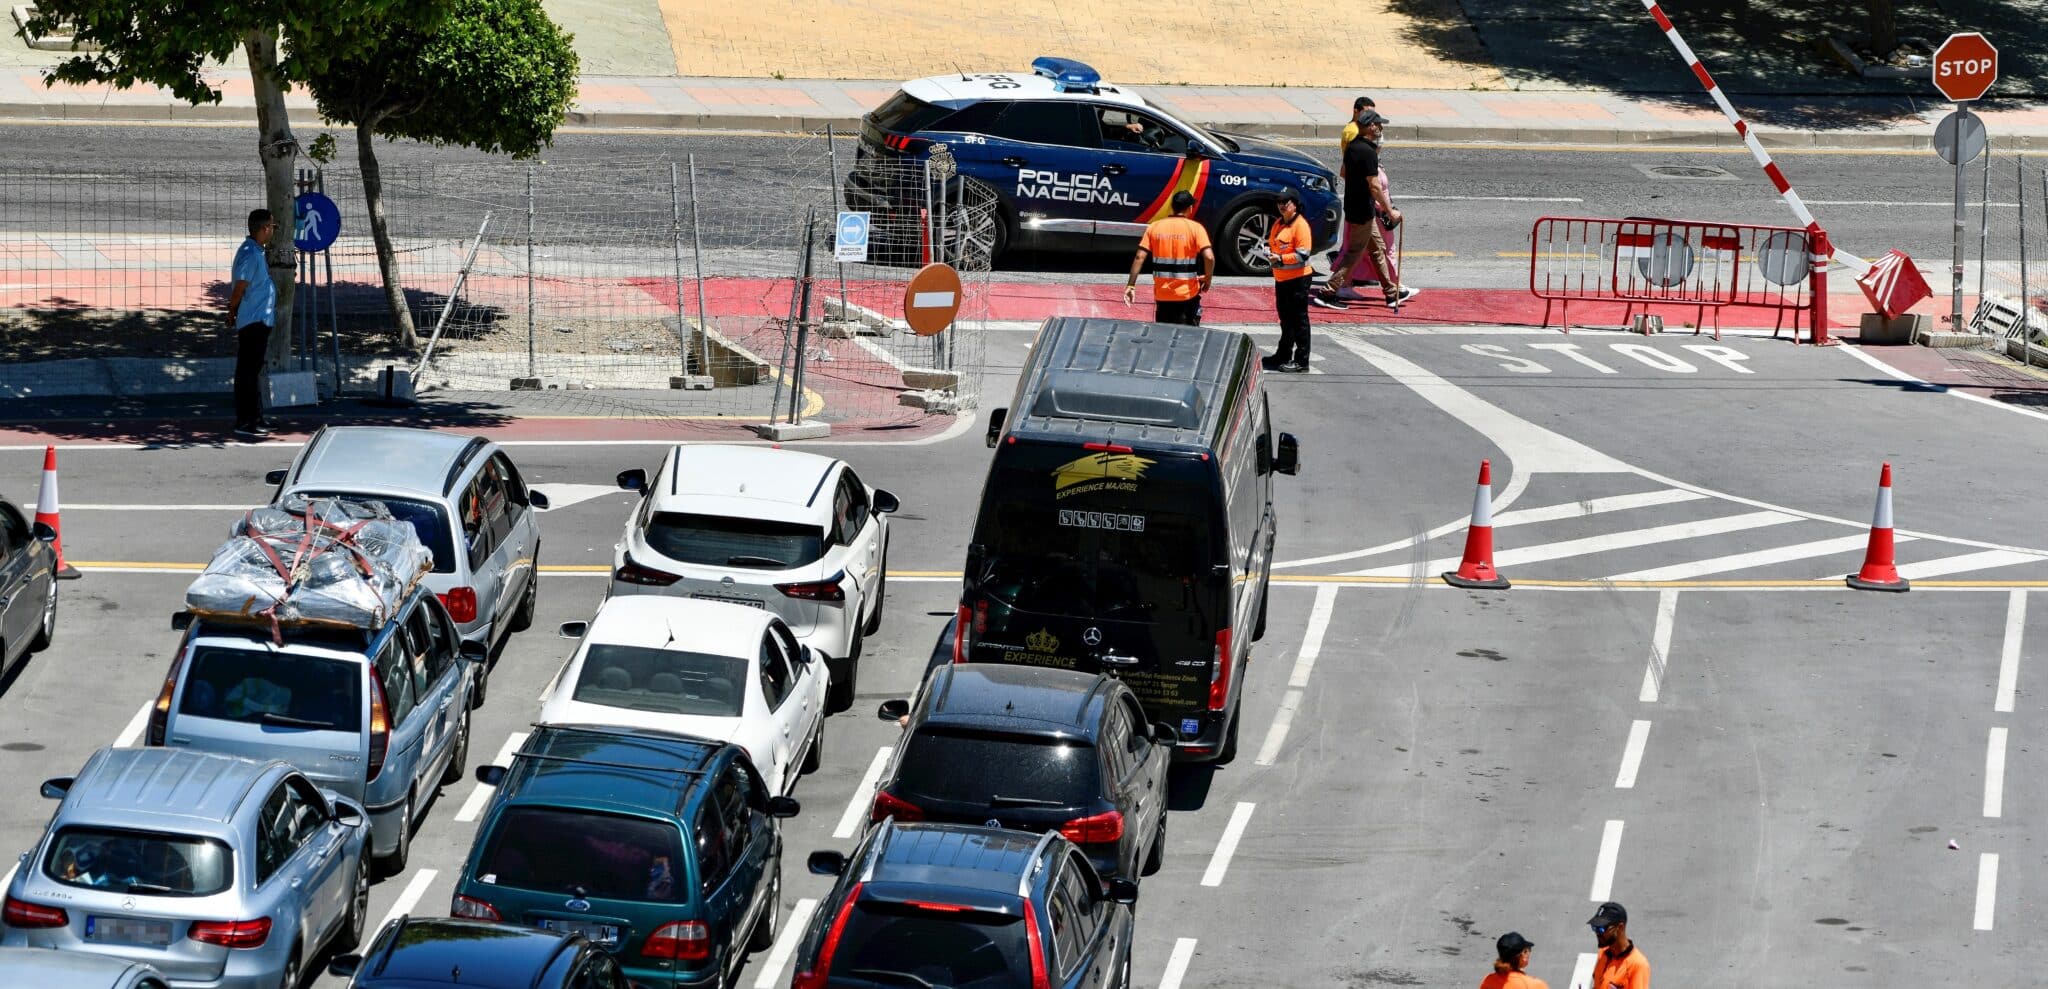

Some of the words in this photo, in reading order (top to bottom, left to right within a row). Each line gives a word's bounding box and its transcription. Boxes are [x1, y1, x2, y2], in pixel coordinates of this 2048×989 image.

[1940, 59, 1992, 77] STOP
[1018, 168, 1112, 191] POLICÍA
[1016, 183, 1140, 207] NACIONAL
[1460, 343, 1755, 374] STOP
[1056, 482, 1104, 500] EXPERIENCE
[1104, 481, 1138, 493] MAJOREL
[1004, 651, 1077, 668] EXPERIENCE
